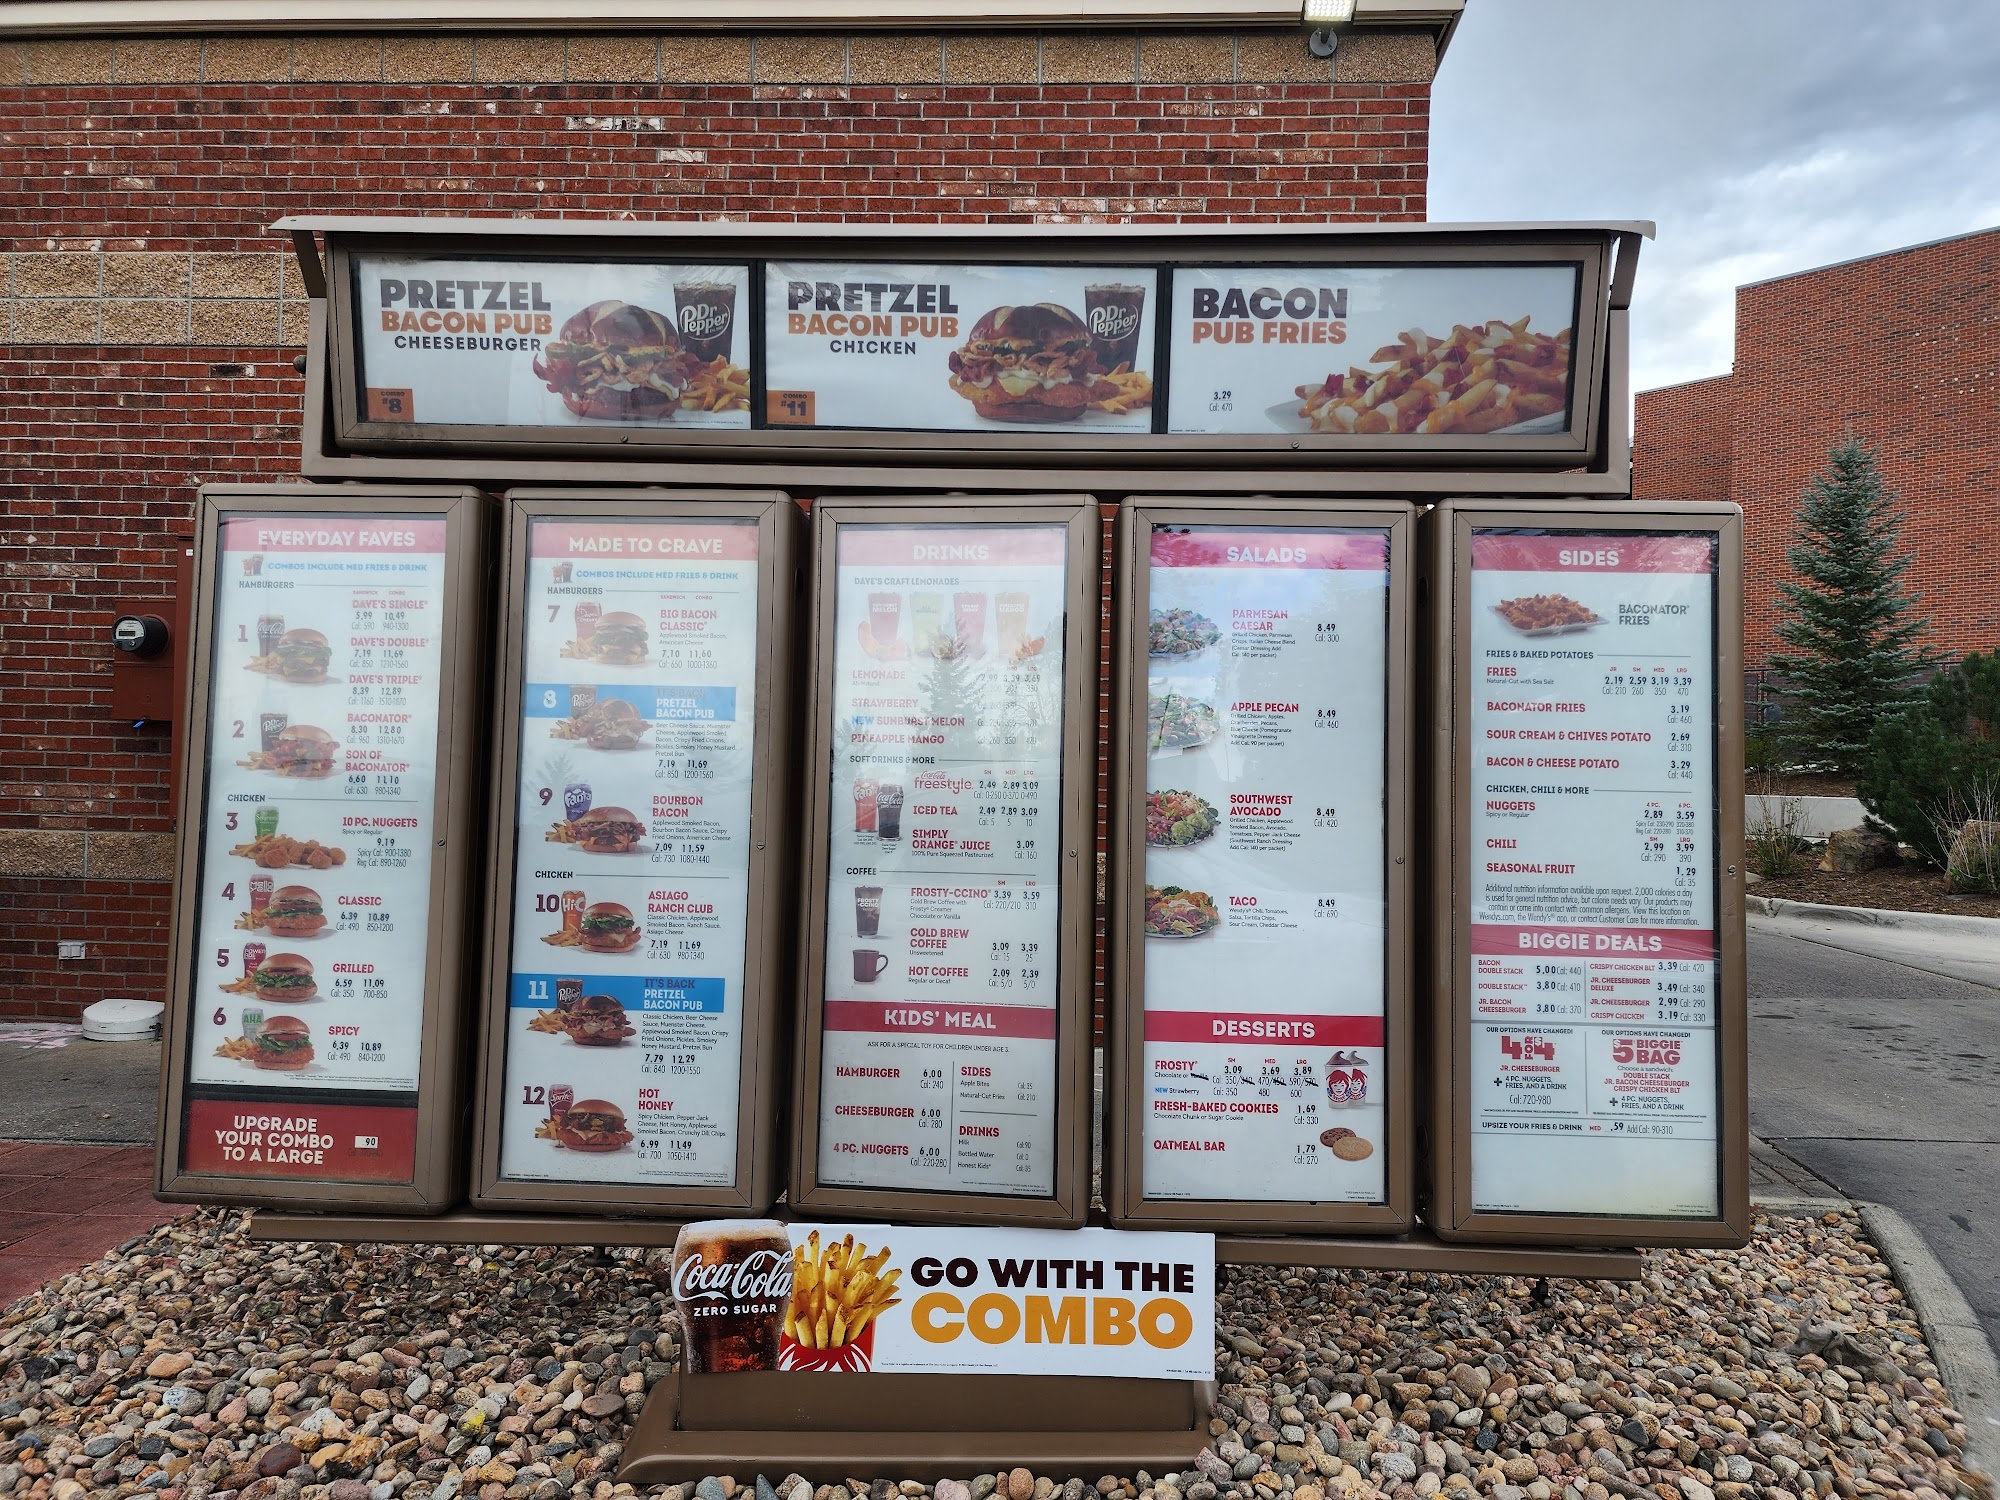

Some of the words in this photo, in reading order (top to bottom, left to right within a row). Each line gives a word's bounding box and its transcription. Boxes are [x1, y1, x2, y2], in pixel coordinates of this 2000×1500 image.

[380, 279, 551, 311] PRETZEL
[788, 282, 958, 313] PRETZEL
[1193, 288, 1347, 319] BACON
[698, 304, 717, 320] Dr
[1106, 306, 1126, 321] Dr
[381, 311, 491, 334] BACON
[494, 313, 552, 335] PUB
[683, 305, 728, 335] Pepper
[788, 313, 896, 336] BACON
[902, 316, 959, 338] PUB
[1091, 307, 1136, 335] Pepper
[1193, 322, 1254, 344] PUB
[1263, 323, 1347, 344] FRIES
[394, 336, 541, 352] CHEESEBURGER
[830, 340, 916, 355] CHICKEN
[1214, 391, 1232, 400] 3.29
[1209, 403, 1219, 412] Cal:
[1221, 403, 1233, 412] 470
[258, 530, 355, 546] EVERYDAY
[359, 532, 415, 546] FAVES
[569, 537, 623, 552] MADE
[628, 538, 652, 552] TO
[658, 539, 722, 554] CRAVE
[913, 545, 990, 561] DRINKS
[1227, 547, 1306, 563] SALADS
[1559, 550, 1619, 566] SIDES
[239, 581, 294, 589] HAMBURGERS
[548, 605, 560, 623] 7
[1619, 615, 1650, 625] FRIES
[238, 625, 248, 642] 1
[1317, 624, 1336, 632] 8.49
[544, 690, 557, 708] 8
[657, 698, 698, 708] PRETZEL
[1231, 702, 1261, 712] APPLE
[1265, 703, 1299, 713] PECAN
[1487, 702, 1552, 712] BACONATOR
[1556, 703, 1586, 713] FRIES
[1671, 705, 1690, 713] 3.19
[656, 709, 692, 718] BACON
[695, 710, 714, 718] PUB
[1318, 710, 1336, 718] 8.49
[233, 720, 244, 738] 2
[1487, 730, 1516, 739] SOUR
[1519, 731, 1555, 740] CREAM
[1559, 732, 1565, 740] &
[1568, 732, 1608, 741] CHIVES
[1611, 733, 1651, 742] POTATO
[1671, 733, 1690, 741] 2.69
[659, 760, 675, 768] 7.19
[687, 760, 708, 768] 11.69
[1487, 757, 1525, 767] BACON
[1527, 758, 1533, 767] &
[1536, 758, 1576, 768] CHEESE
[1579, 759, 1620, 769] POTATO
[1671, 761, 1690, 769] 3.29
[539, 788, 553, 805] 9
[653, 796, 703, 805] BOURBON
[1230, 795, 1293, 805] SOUTHWEST
[913, 806, 937, 815] ICED
[940, 806, 958, 815] TEA
[1230, 807, 1281, 816] AVOCADO
[1487, 801, 1535, 811] NUGGETS
[653, 808, 688, 817] BACON
[1316, 808, 1335, 817] 8.49
[225, 812, 238, 830] 3
[343, 817, 353, 826] 10
[355, 818, 371, 827] PC.
[372, 818, 418, 827] NUGGETS
[655, 843, 672, 851] 7.09
[682, 844, 705, 852] 11.59
[1487, 839, 1517, 848] CHILI
[1487, 863, 1542, 873] SEASONAL
[1545, 864, 1575, 874] FRUIT
[222, 883, 235, 900] 4
[649, 891, 688, 900] ASIAGO
[1486, 884, 1512, 893] Additional
[1514, 885, 1536, 893] nutrition
[1538, 885, 1568, 894] information
[1570, 886, 1594, 895] available
[1596, 888, 1609, 896] upon
[1635, 887, 1653, 896] 2,000
[1655, 888, 1675, 897] calories
[1682, 888, 1692, 898] day
[338, 896, 382, 906] CLASSIC
[536, 894, 559, 912] 10
[1230, 897, 1257, 906] TACO
[648, 904, 685, 913] RANCH
[687, 904, 714, 913] CLUB
[341, 912, 358, 920] 6.39
[368, 913, 389, 921] 10.89
[911, 928, 936, 938] COLD
[940, 929, 969, 938] BREW
[651, 940, 668, 949] 7.19
[679, 941, 701, 949] 11.69
[910, 939, 947, 949] COFFEE
[1519, 933, 1589, 949] BIGGIE
[1595, 935, 1662, 951] DEALS
[217, 949, 229, 967] 5
[333, 964, 374, 973] GRILLED
[908, 967, 929, 976] HOT
[932, 967, 968, 977] COFFEE
[528, 981, 548, 999] 11
[644, 990, 686, 999] PRETZEL
[644, 1000, 680, 1010] BACON
[682, 1001, 703, 1010] PUB
[213, 1007, 226, 1025] 6
[884, 1010, 939, 1026] KIDS'
[945, 1012, 996, 1029] MEAL
[329, 1026, 359, 1036] SPICY
[1212, 1020, 1315, 1038] DESSERTS
[333, 1042, 349, 1050] 6.39
[361, 1042, 382, 1051] 10.89
[1637, 1040, 1681, 1049] BIGGIE
[1637, 1050, 1680, 1065] BAG
[836, 1067, 900, 1078] HAMBURGER
[923, 1070, 942, 1078] 6.00
[961, 1067, 991, 1077] SIDES
[523, 1086, 545, 1104] 12
[639, 1089, 659, 1098] HOT
[639, 1101, 674, 1111] HONEY
[835, 1106, 914, 1117] CHEESEBURGER
[1154, 1101, 1227, 1113] FRESH-BAKED
[1230, 1103, 1279, 1114] COOKIES
[921, 1109, 940, 1117] 6.00
[234, 1116, 318, 1132] UPGRADE
[959, 1126, 999, 1137] DRINKS
[215, 1130, 262, 1146] YOUR
[268, 1133, 334, 1149] COMBO
[833, 1143, 840, 1152] 4
[842, 1144, 858, 1153] PC.
[861, 1144, 909, 1155] NUGGETS
[1153, 1140, 1201, 1151] OATMEAL
[1204, 1141, 1225, 1151] BAR
[223, 1147, 245, 1161] TO
[249, 1149, 262, 1162] A
[267, 1149, 324, 1165] LARGE
[919, 1147, 939, 1156] 6.00
[674, 1250, 794, 1301] Coca-Cola
[911, 1257, 978, 1288] GO
[985, 1259, 1108, 1290] WITH
[1115, 1262, 1194, 1293] THE
[693, 1304, 729, 1316] ZERO
[733, 1304, 777, 1316] SUGAR
[911, 1293, 1194, 1350] COMBO
